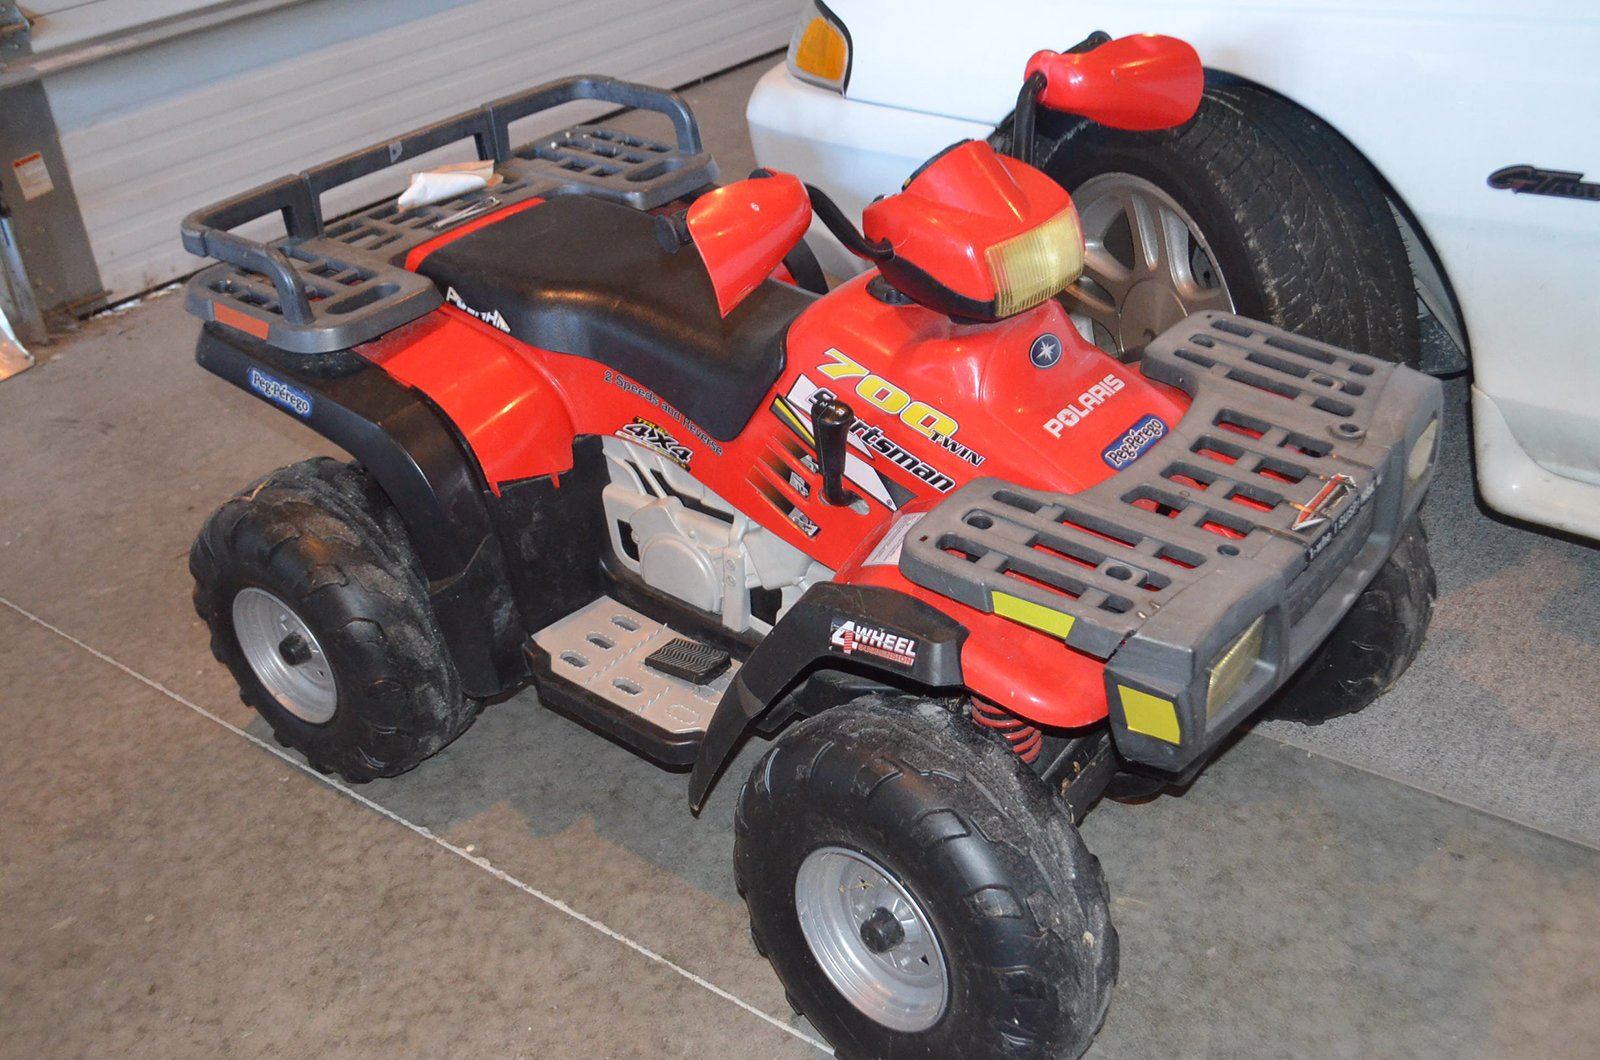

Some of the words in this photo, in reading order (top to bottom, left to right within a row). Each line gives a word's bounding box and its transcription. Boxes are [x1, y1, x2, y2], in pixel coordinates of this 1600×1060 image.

[604, 370, 613, 383] 2
[615, 375, 659, 406] Speeds
[661, 402, 682, 422] and
[682, 416, 722, 456] Reverse
[816, 347, 959, 438] 700
[1043, 374, 1125, 438] POLARIS
[928, 429, 987, 468] TWIN
